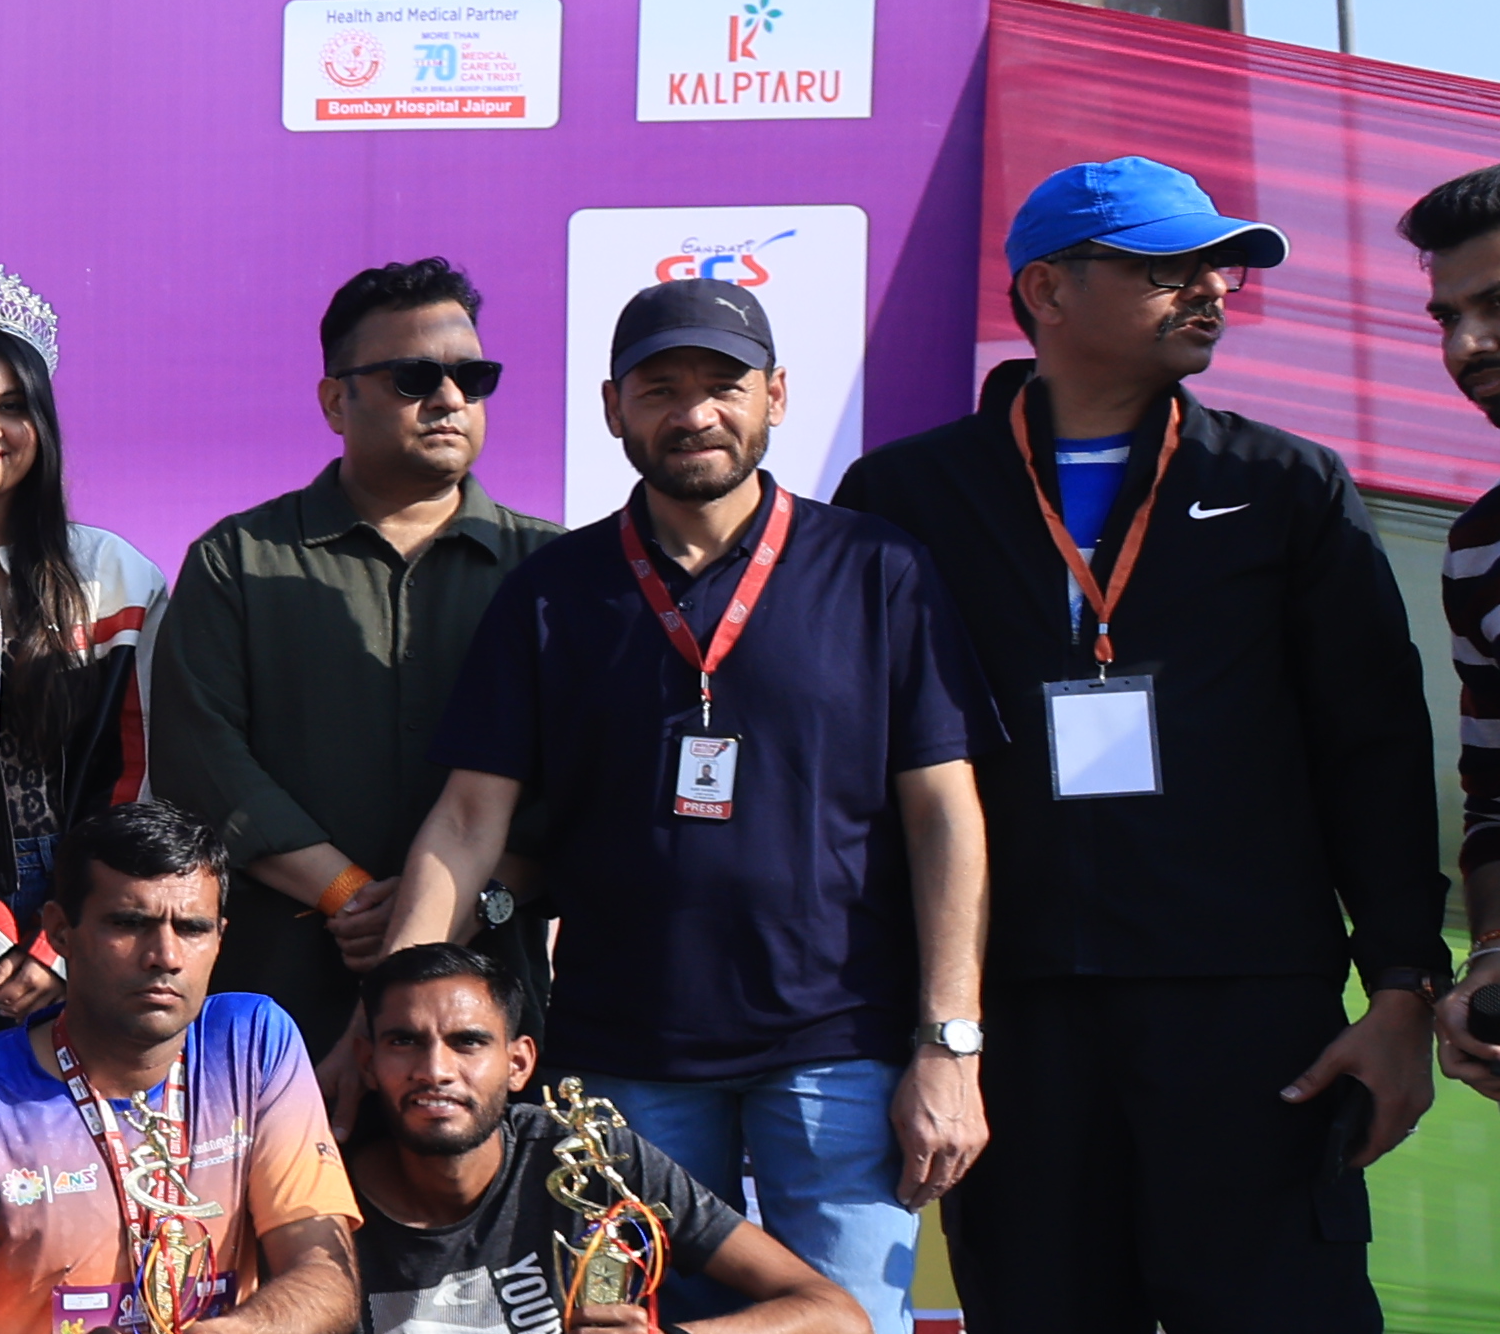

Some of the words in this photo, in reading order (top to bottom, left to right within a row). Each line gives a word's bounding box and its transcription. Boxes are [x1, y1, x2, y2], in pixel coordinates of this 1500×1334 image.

[326, 8, 373, 24] Health
[377, 8, 404, 23] and
[407, 7, 462, 23] Medical
[465, 6, 520, 22] Partner
[421, 31, 450, 40] MORE
[453, 31, 480, 40] THAN
[413, 43, 457, 81] 70
[461, 51, 508, 61] MEDICAL
[461, 62, 491, 72] CARE
[494, 62, 517, 71] YOU
[461, 72, 484, 82] CAN
[487, 72, 522, 82] TRUST
[668, 70, 842, 106] KALPTARU
[328, 100, 392, 116] Bombay
[395, 99, 460, 115] Hospital
[462, 99, 513, 115] Jaipur
[682, 801, 724, 814] PRESS
